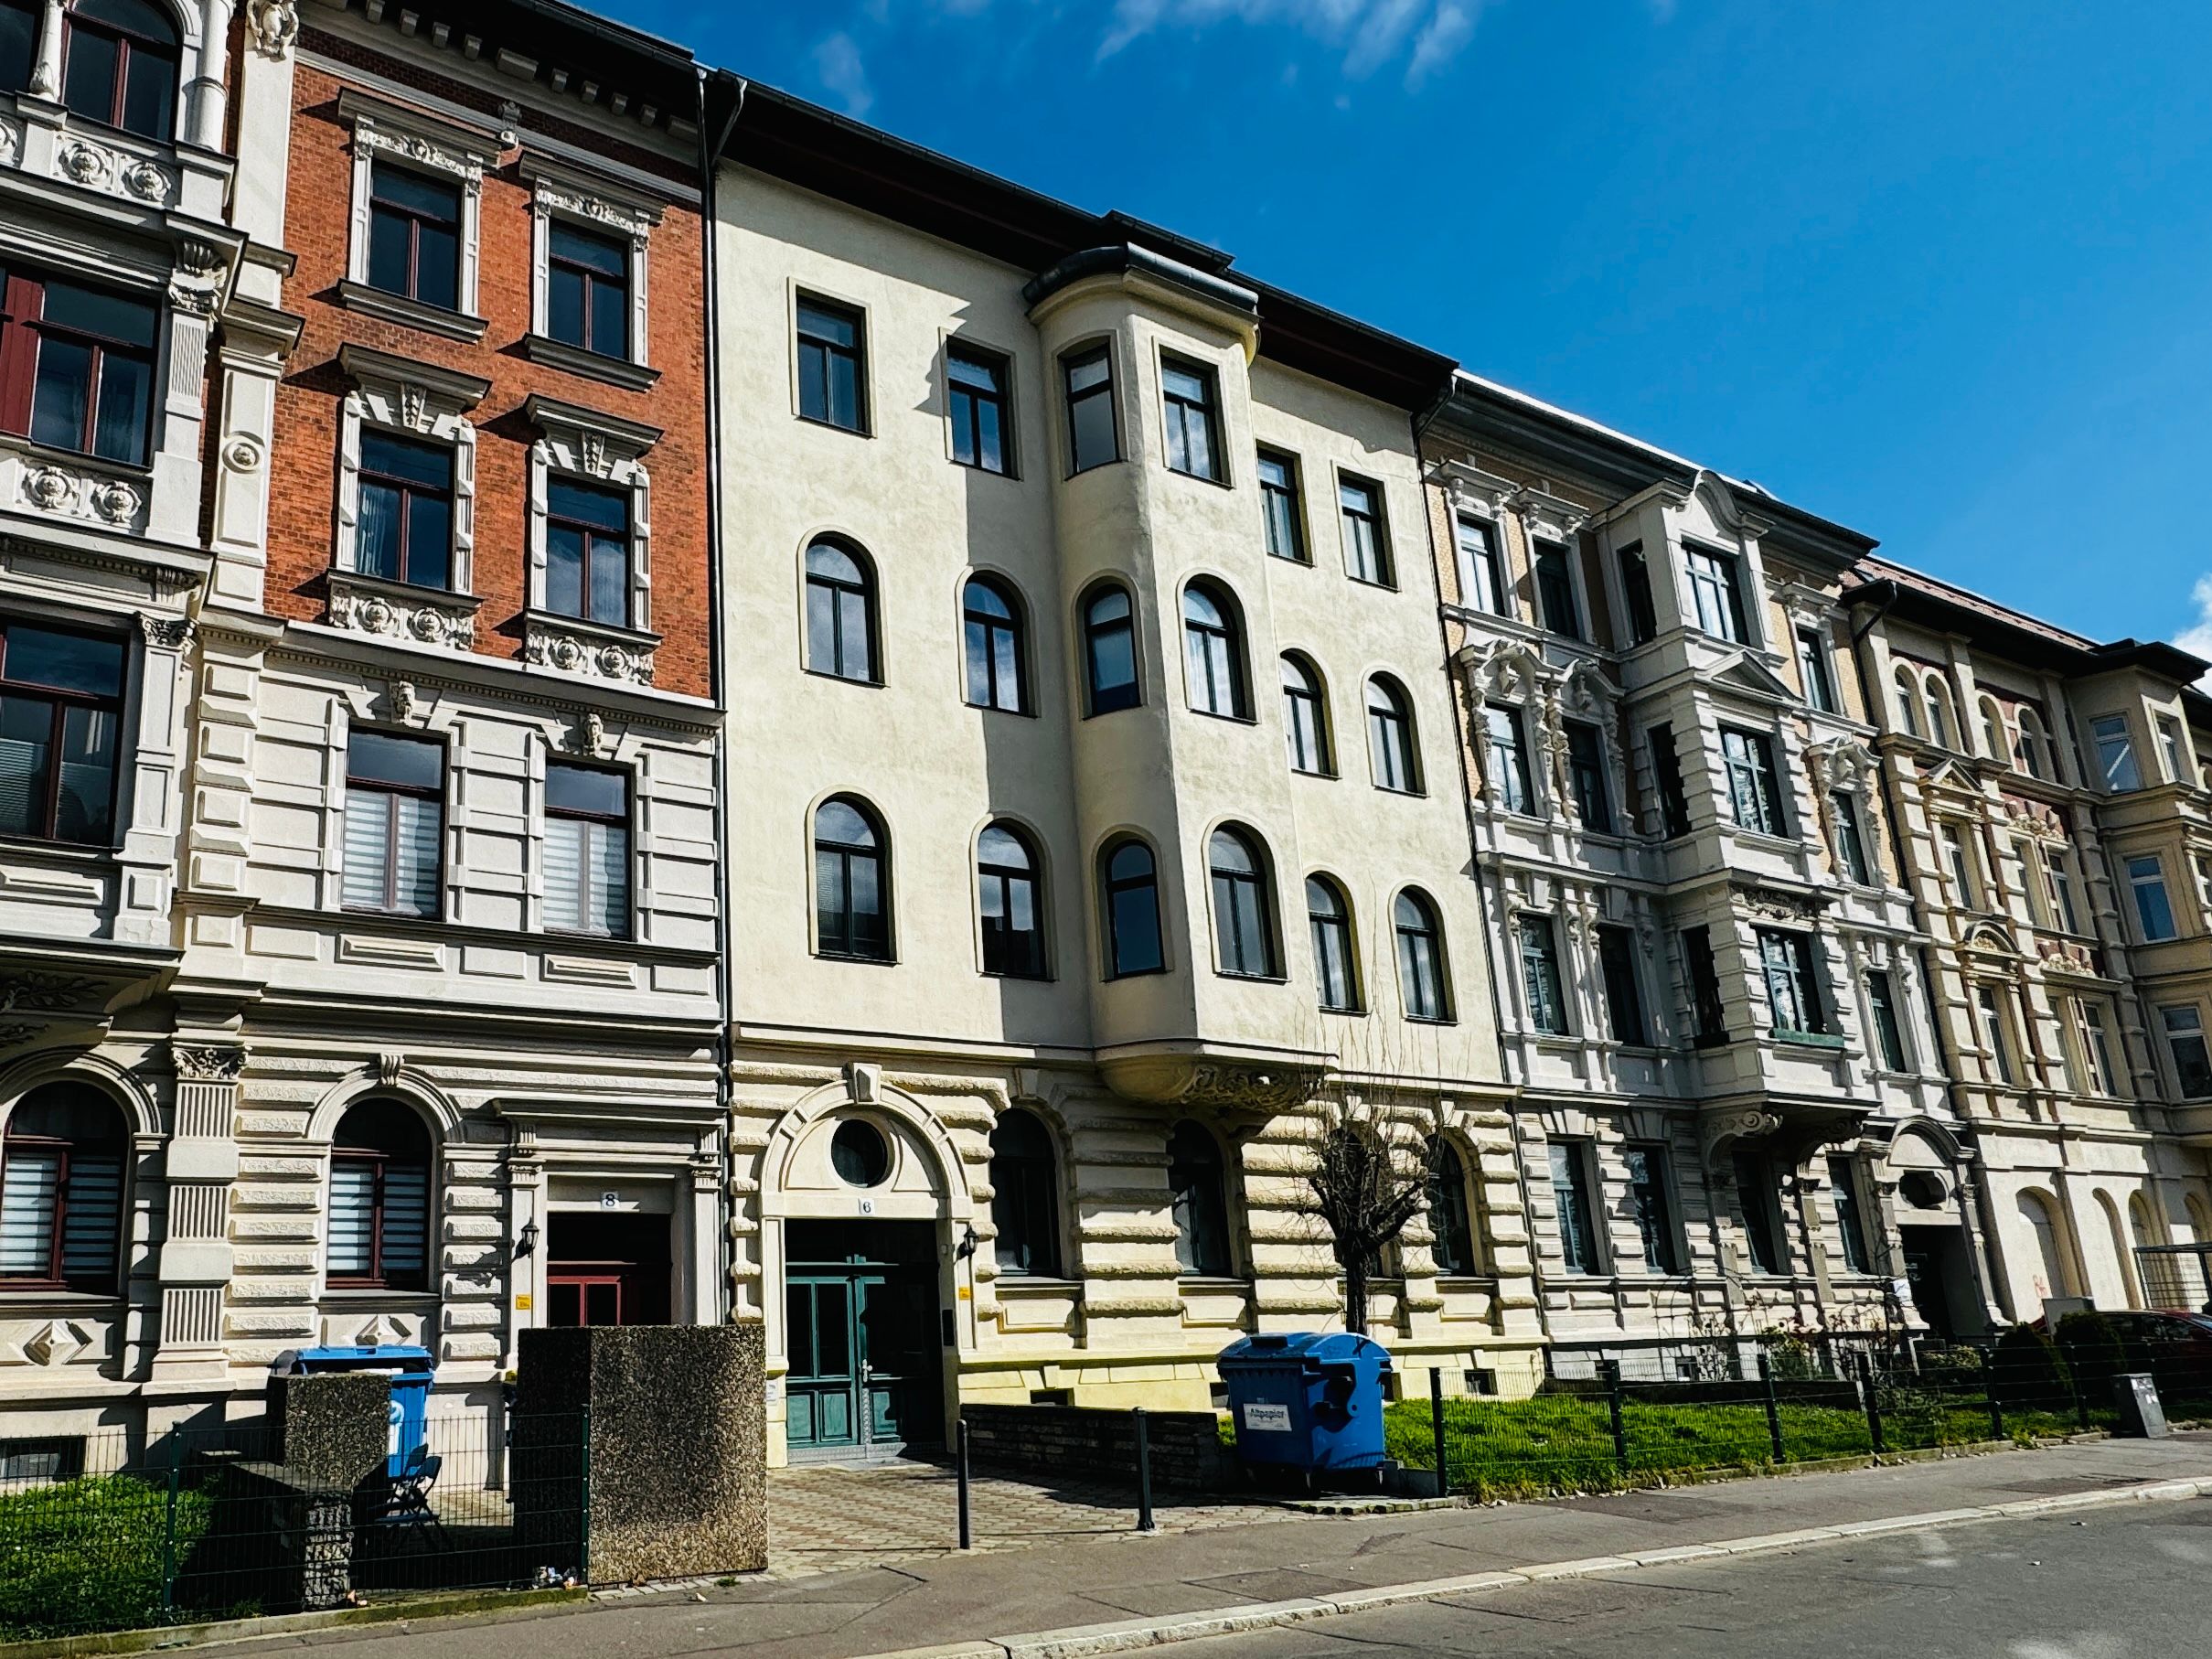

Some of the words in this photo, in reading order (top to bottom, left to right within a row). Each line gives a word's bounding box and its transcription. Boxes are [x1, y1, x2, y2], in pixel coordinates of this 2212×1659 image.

[605, 1193, 615, 1207] 8
[862, 1202, 871, 1214] 6
[1250, 1407, 1285, 1420] Altpapier
